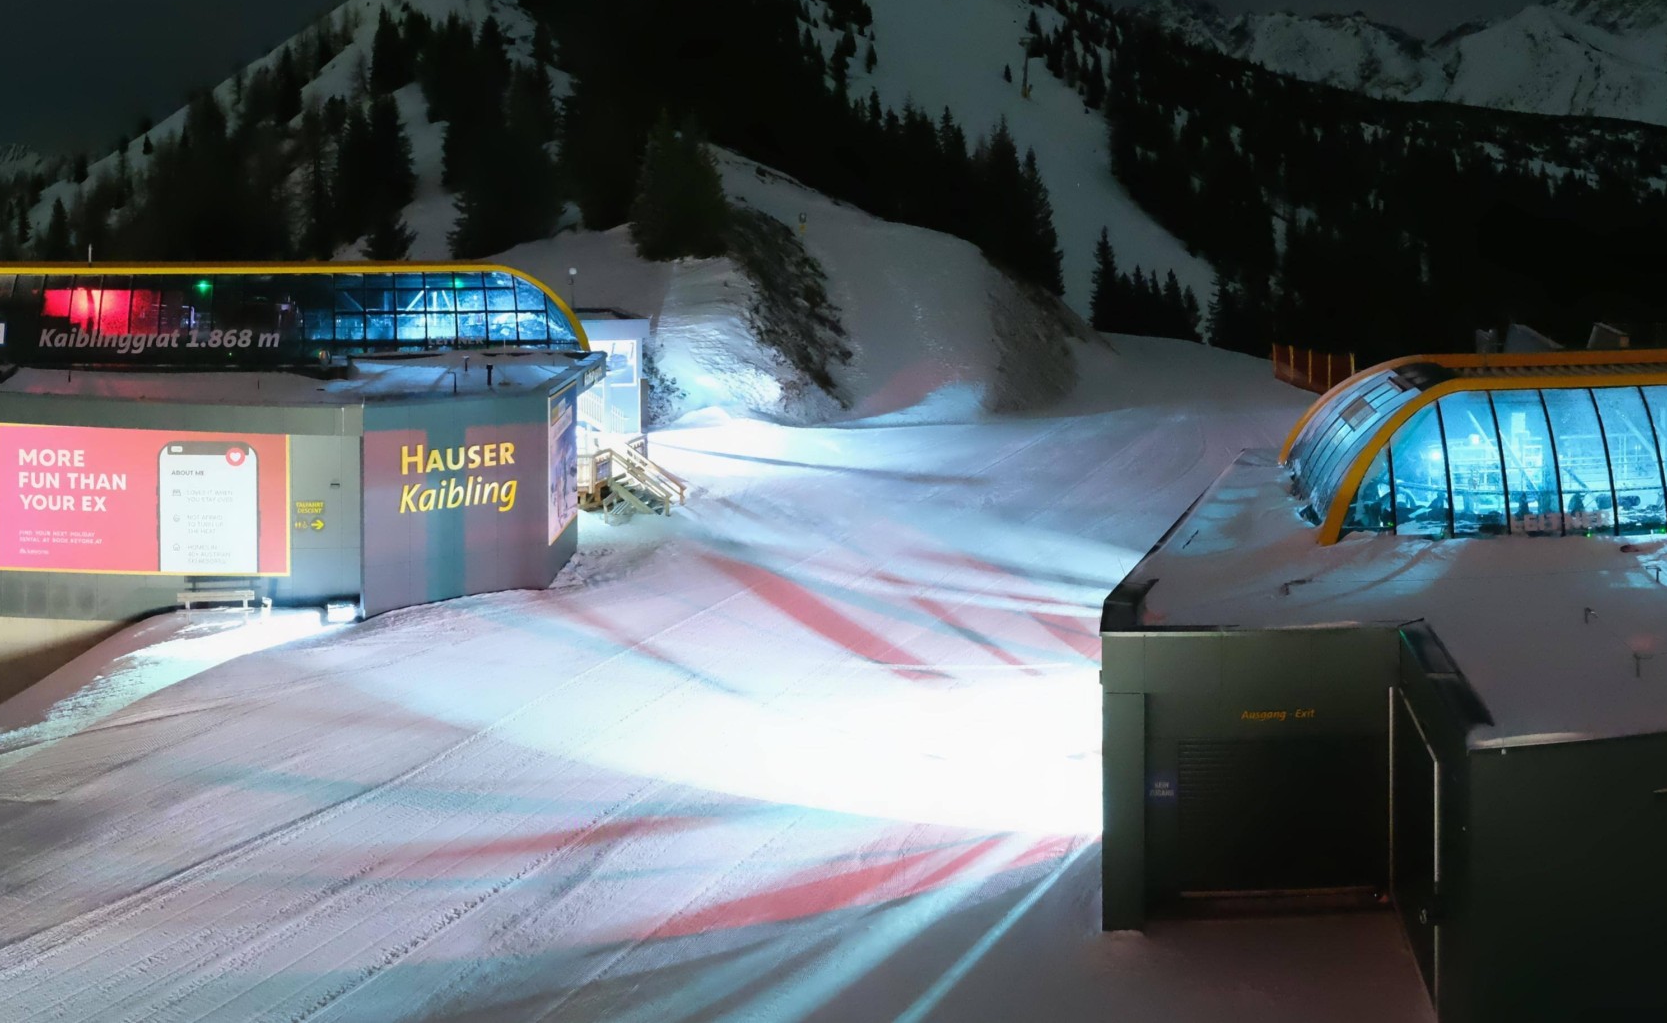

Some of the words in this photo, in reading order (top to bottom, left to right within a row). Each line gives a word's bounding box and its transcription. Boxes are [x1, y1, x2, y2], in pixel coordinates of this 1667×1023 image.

[39, 329, 180, 354] Kaiblinggrat
[186, 329, 251, 347] 1.868
[258, 334, 279, 347] m
[18, 449, 85, 467] MORE
[402, 442, 515, 475] HAUSER
[18, 472, 60, 489] FUN
[67, 473, 126, 490] THAN
[19, 495, 75, 511] YOUR
[82, 496, 107, 512] EX
[400, 476, 517, 513] Kaibling
[1241, 710, 1286, 721] Ausgang
[1295, 709, 1315, 718] Exit
